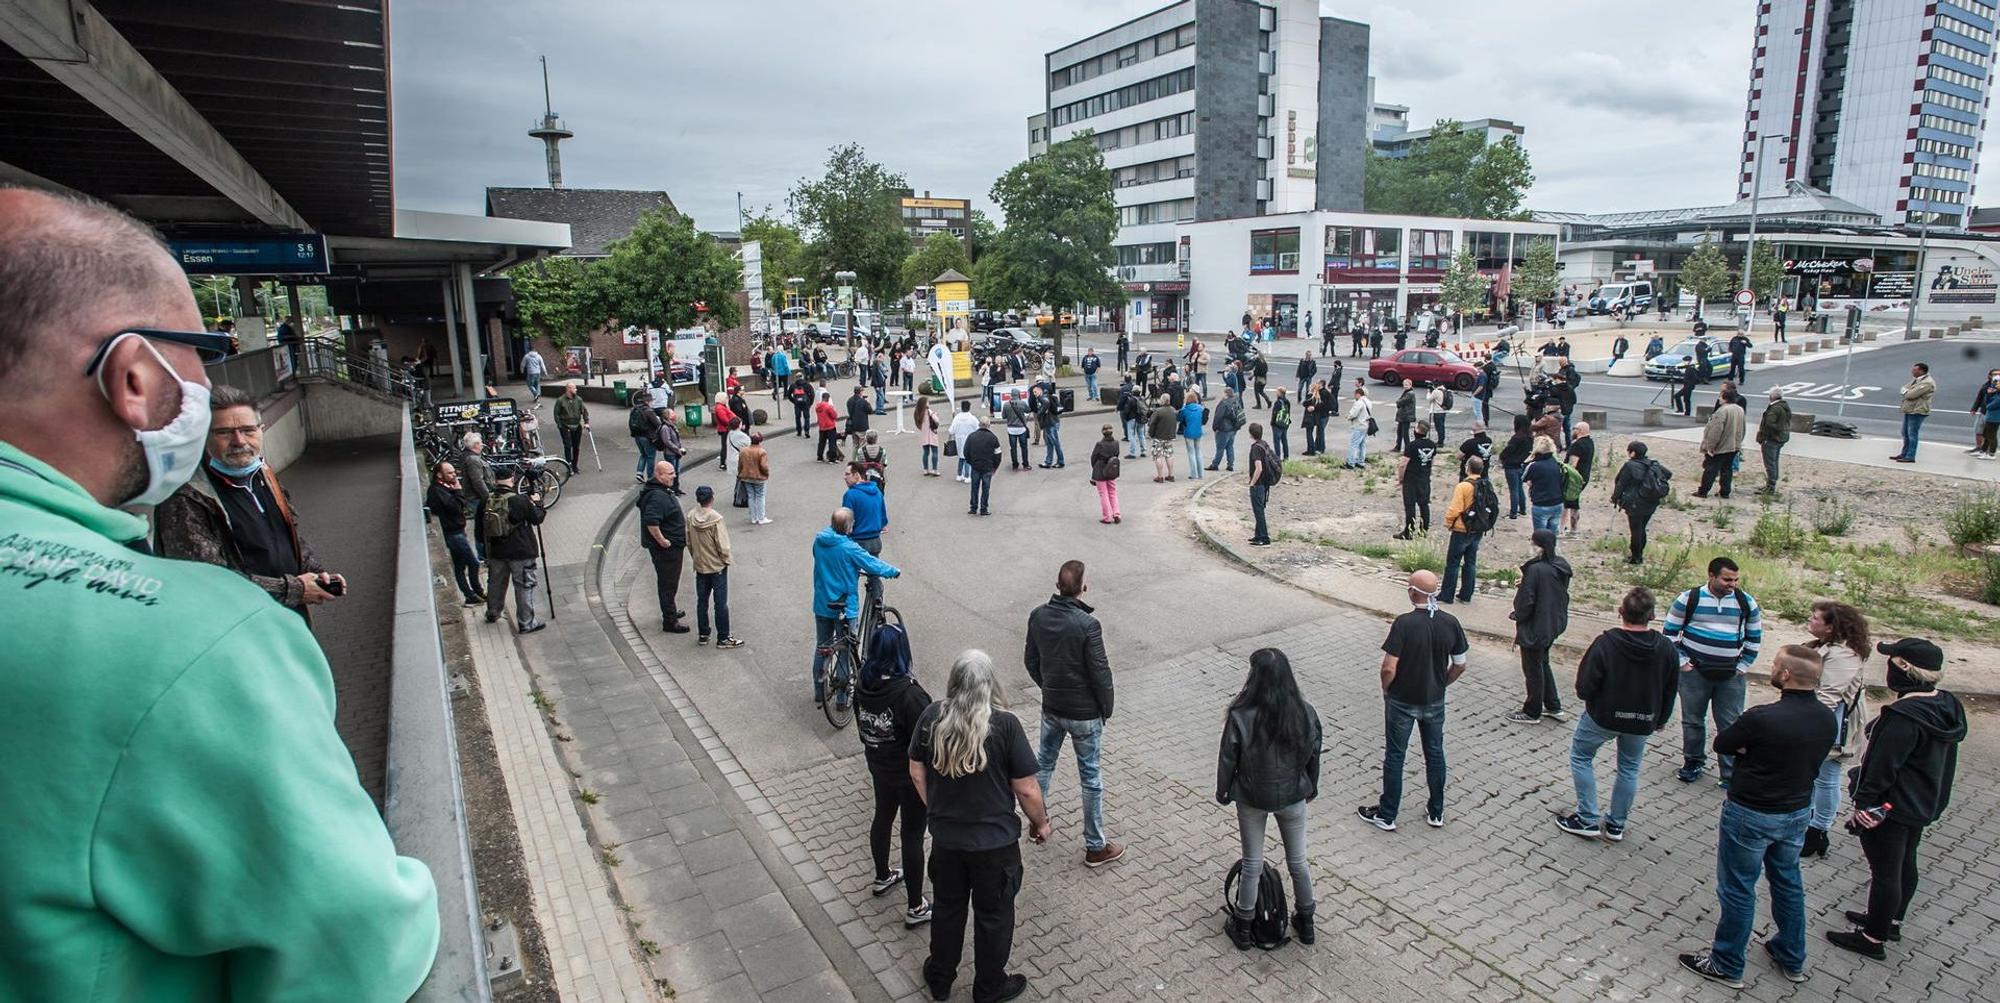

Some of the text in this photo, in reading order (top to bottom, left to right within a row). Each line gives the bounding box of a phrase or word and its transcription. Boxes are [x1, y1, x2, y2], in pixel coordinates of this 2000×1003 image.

[297, 243, 314, 252] S 6
[183, 254, 213, 263] Essen
[1954, 266, 1989, 276] Uncle
[1762, 382, 1883, 399] BUS
[439, 403, 480, 414] FITNESS
[2, 559, 159, 606] High Waves
[82, 563, 163, 594] DAVID
